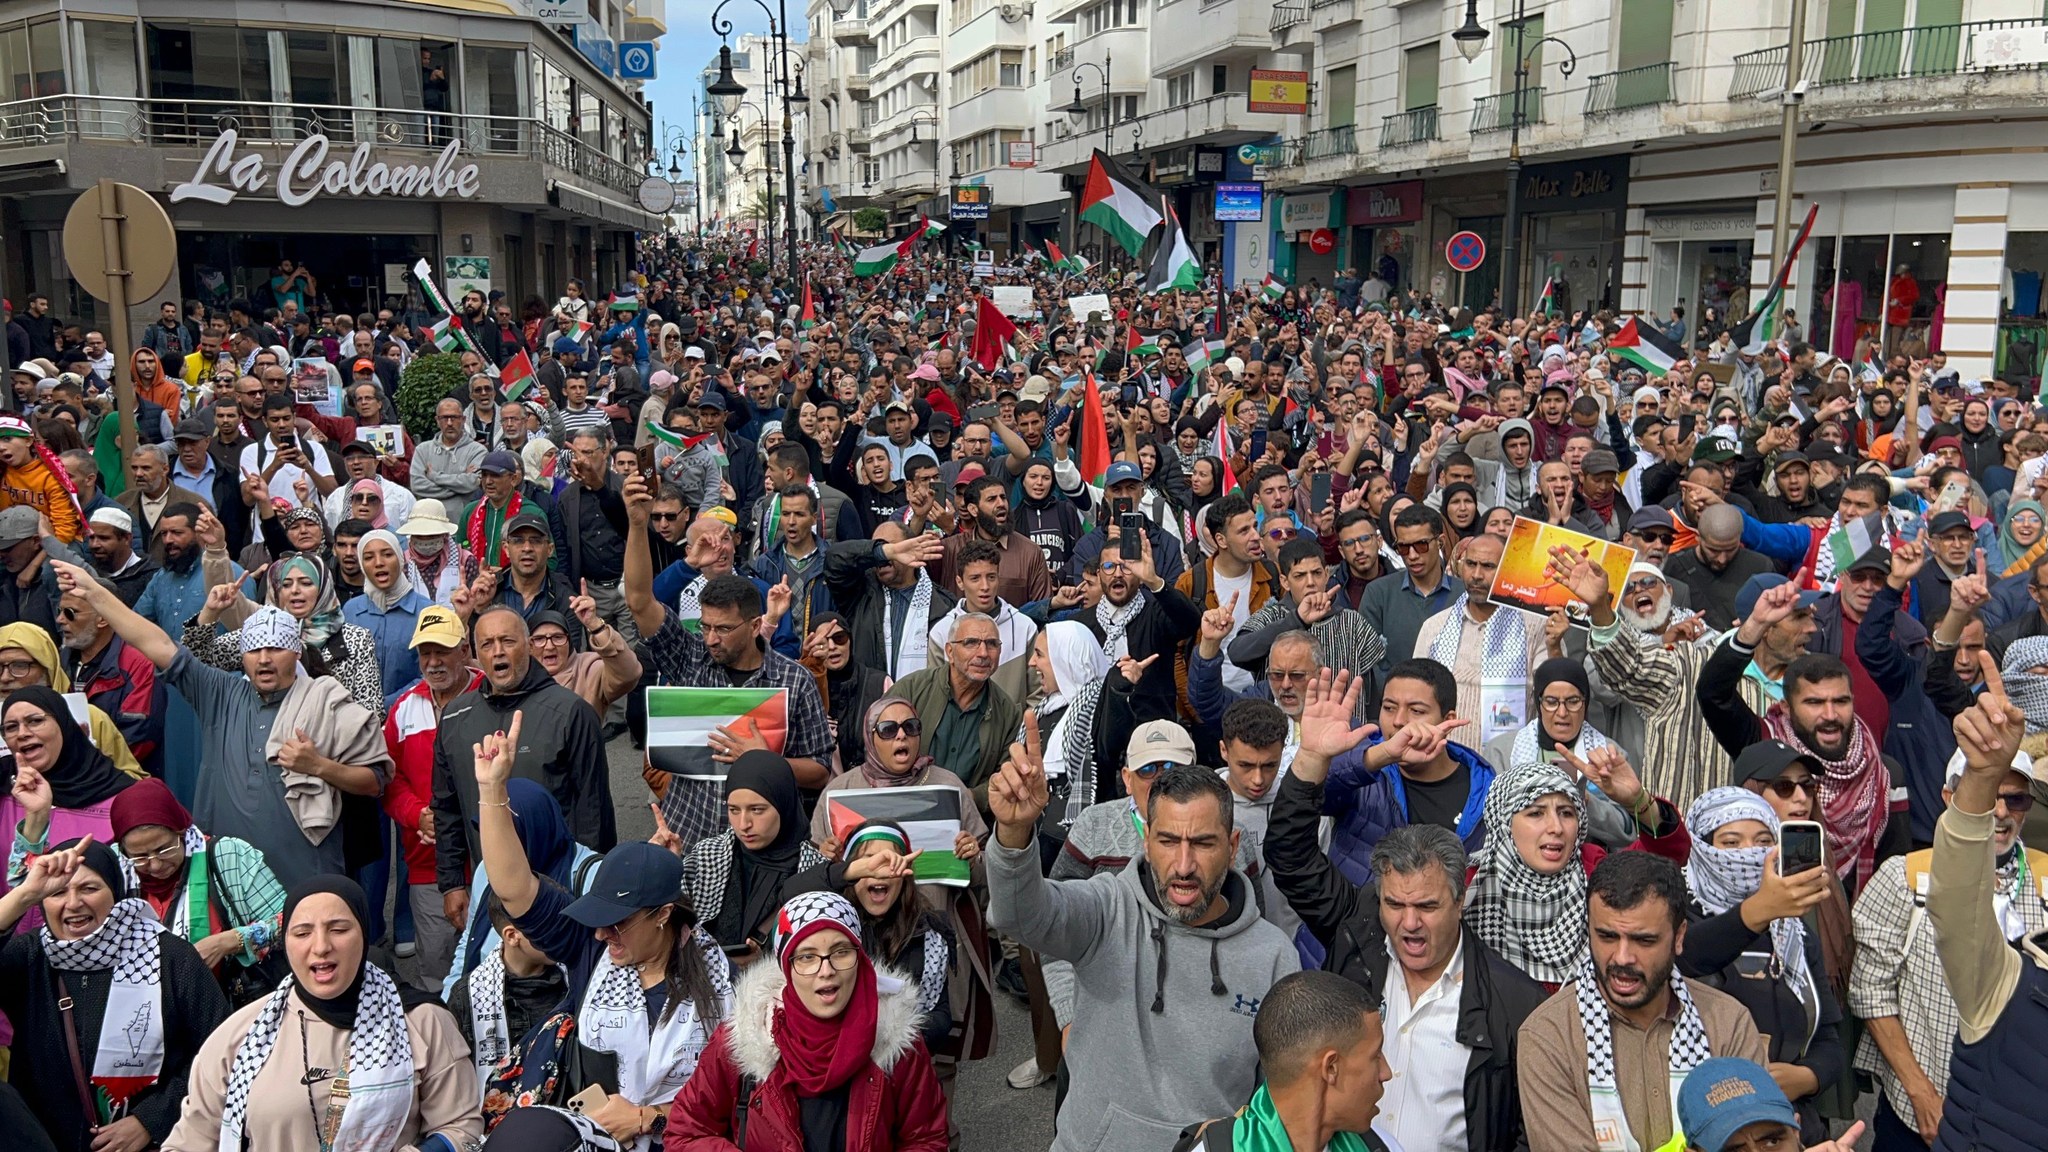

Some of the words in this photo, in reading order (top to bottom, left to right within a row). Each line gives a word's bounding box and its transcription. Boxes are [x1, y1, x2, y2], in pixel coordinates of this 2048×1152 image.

[538, 9, 558, 18] CAT
[170, 129, 268, 205] La
[277, 134, 480, 207] Colombe
[1525, 175, 1559, 200] Max
[1570, 169, 1610, 198] Belle
[1294, 203, 1309, 215] CASH
[1369, 197, 1401, 218] MODA
[1688, 217, 1722, 232] fashion
[1723, 218, 1731, 229] is
[477, 1012, 503, 1021] PESE
[590, 1015, 628, 1033] القدس
[113, 1059, 145, 1068] فلسطين
[308, 1066, 330, 1078] NIKE
